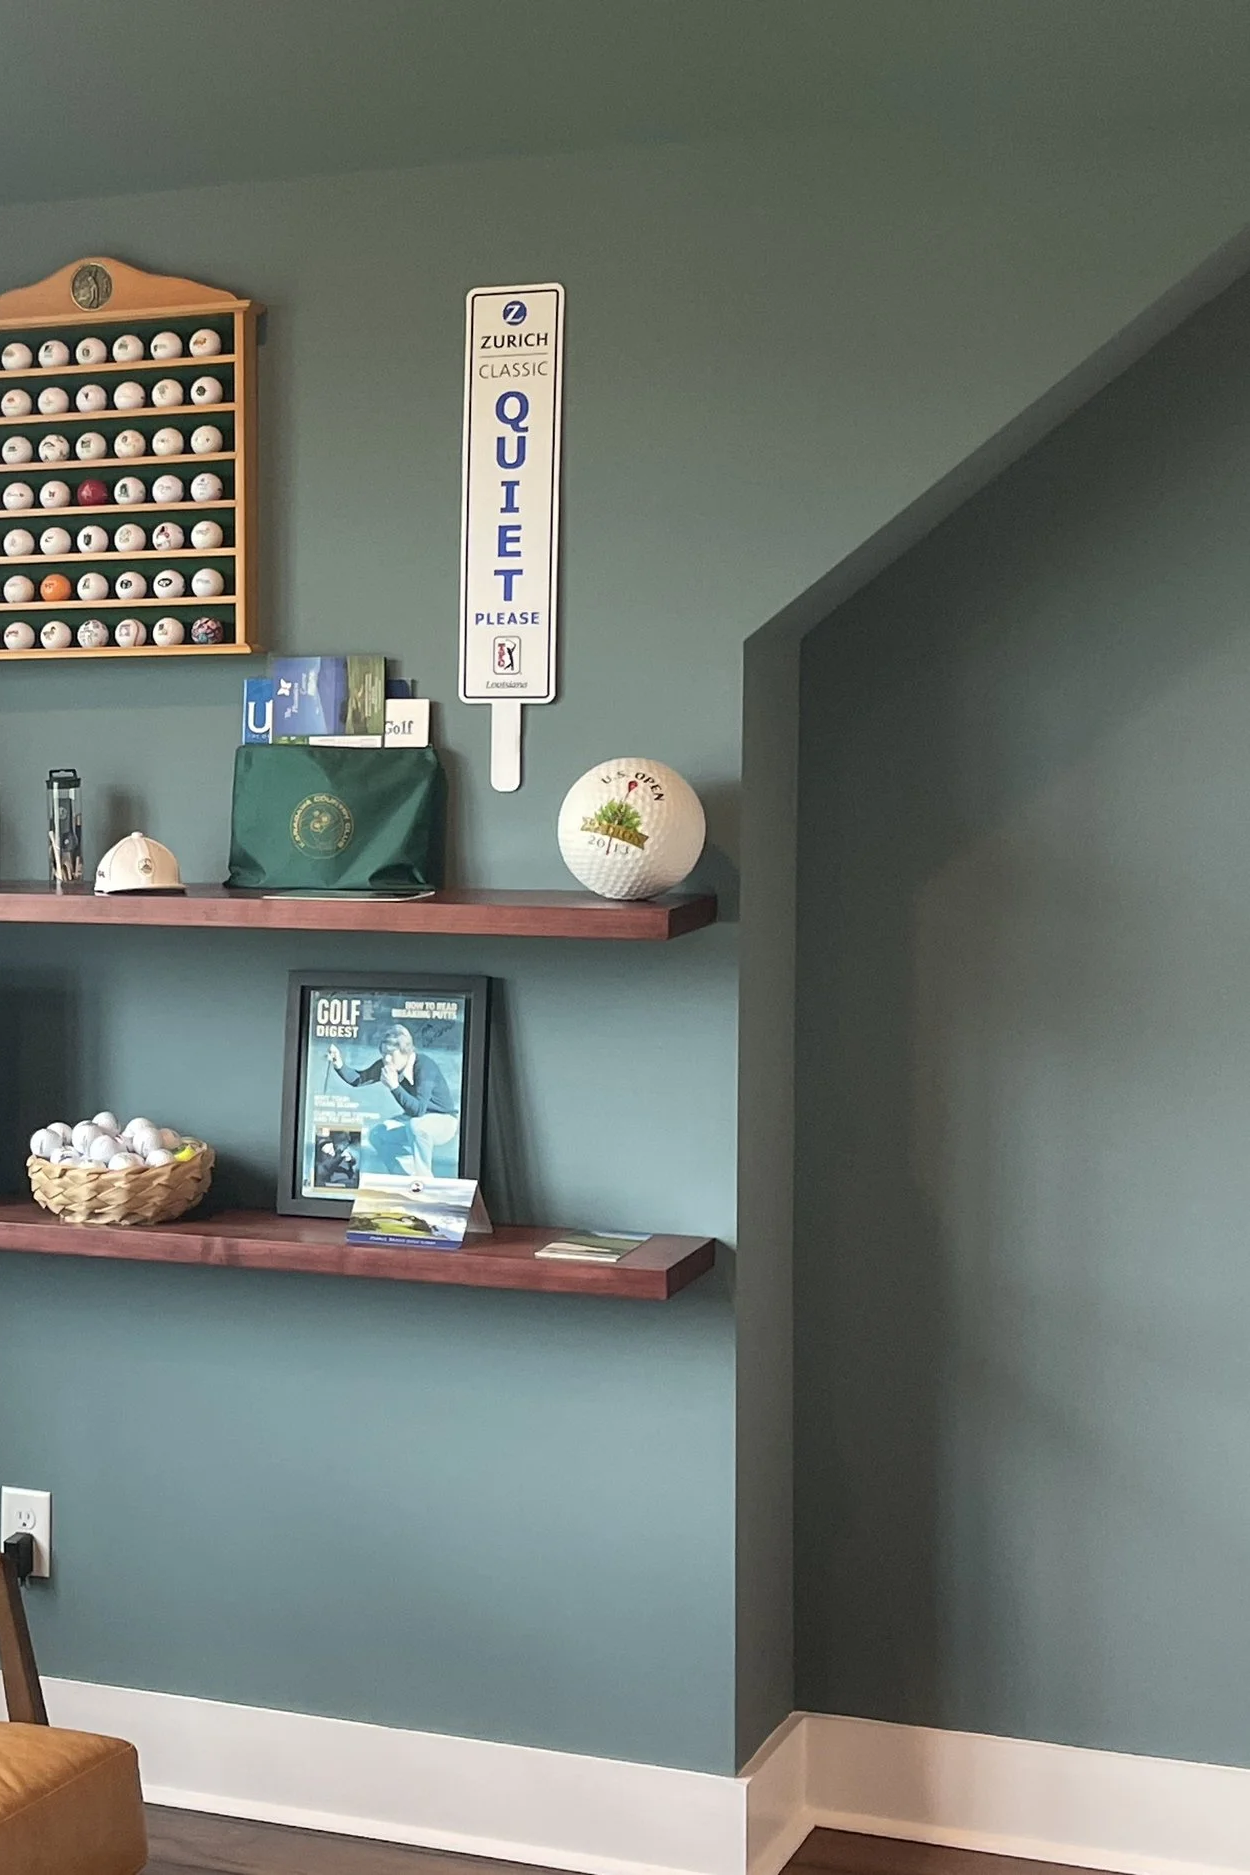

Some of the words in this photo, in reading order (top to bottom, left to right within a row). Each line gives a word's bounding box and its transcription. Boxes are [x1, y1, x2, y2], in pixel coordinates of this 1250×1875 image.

[480, 332, 548, 350] ZURICH
[478, 361, 548, 379] CLASSIC
[494, 390, 529, 602] QUIET
[475, 611, 540, 626] PLEASE
[485, 680, 528, 690] Louisiana
[384, 720, 414, 735] Golf
[634, 772, 665, 801] OPEN
[313, 795, 350, 820] COUNTRY
[337, 821, 351, 848] CLUB
[317, 998, 361, 1026] GOLF
[405, 1001, 424, 1010] HOW
[424, 1001, 435, 1010] TO
[316, 1024, 359, 1039] DIGEST
